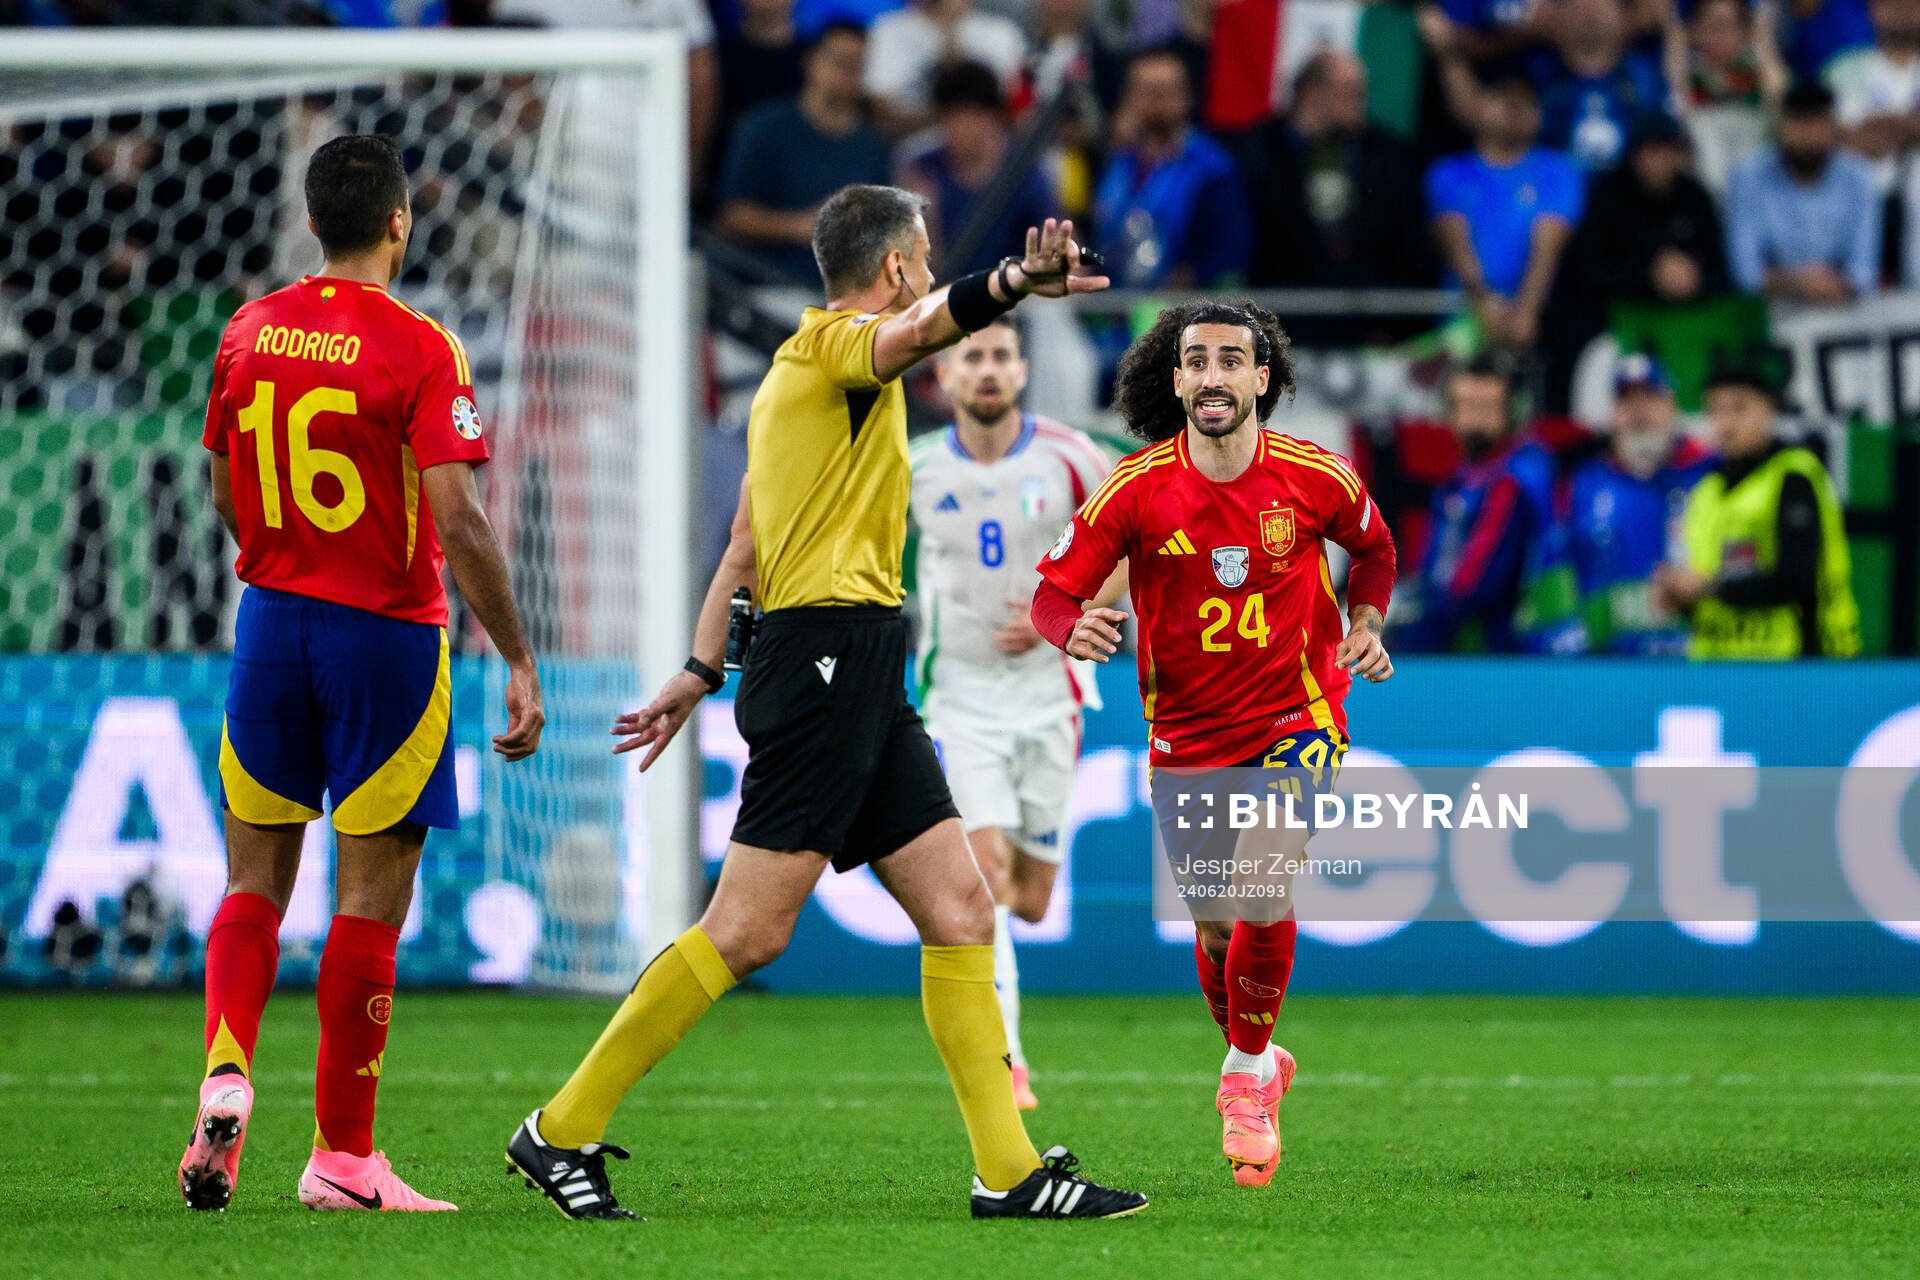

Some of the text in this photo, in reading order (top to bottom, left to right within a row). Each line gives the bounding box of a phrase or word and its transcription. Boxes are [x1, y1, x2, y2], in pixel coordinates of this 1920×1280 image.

[254, 324, 361, 365] RODRIGO
[237, 380, 366, 533] 16
[979, 520, 1004, 569] 8
[1198, 592, 1271, 652] 24
[1263, 738, 1329, 788] 24
